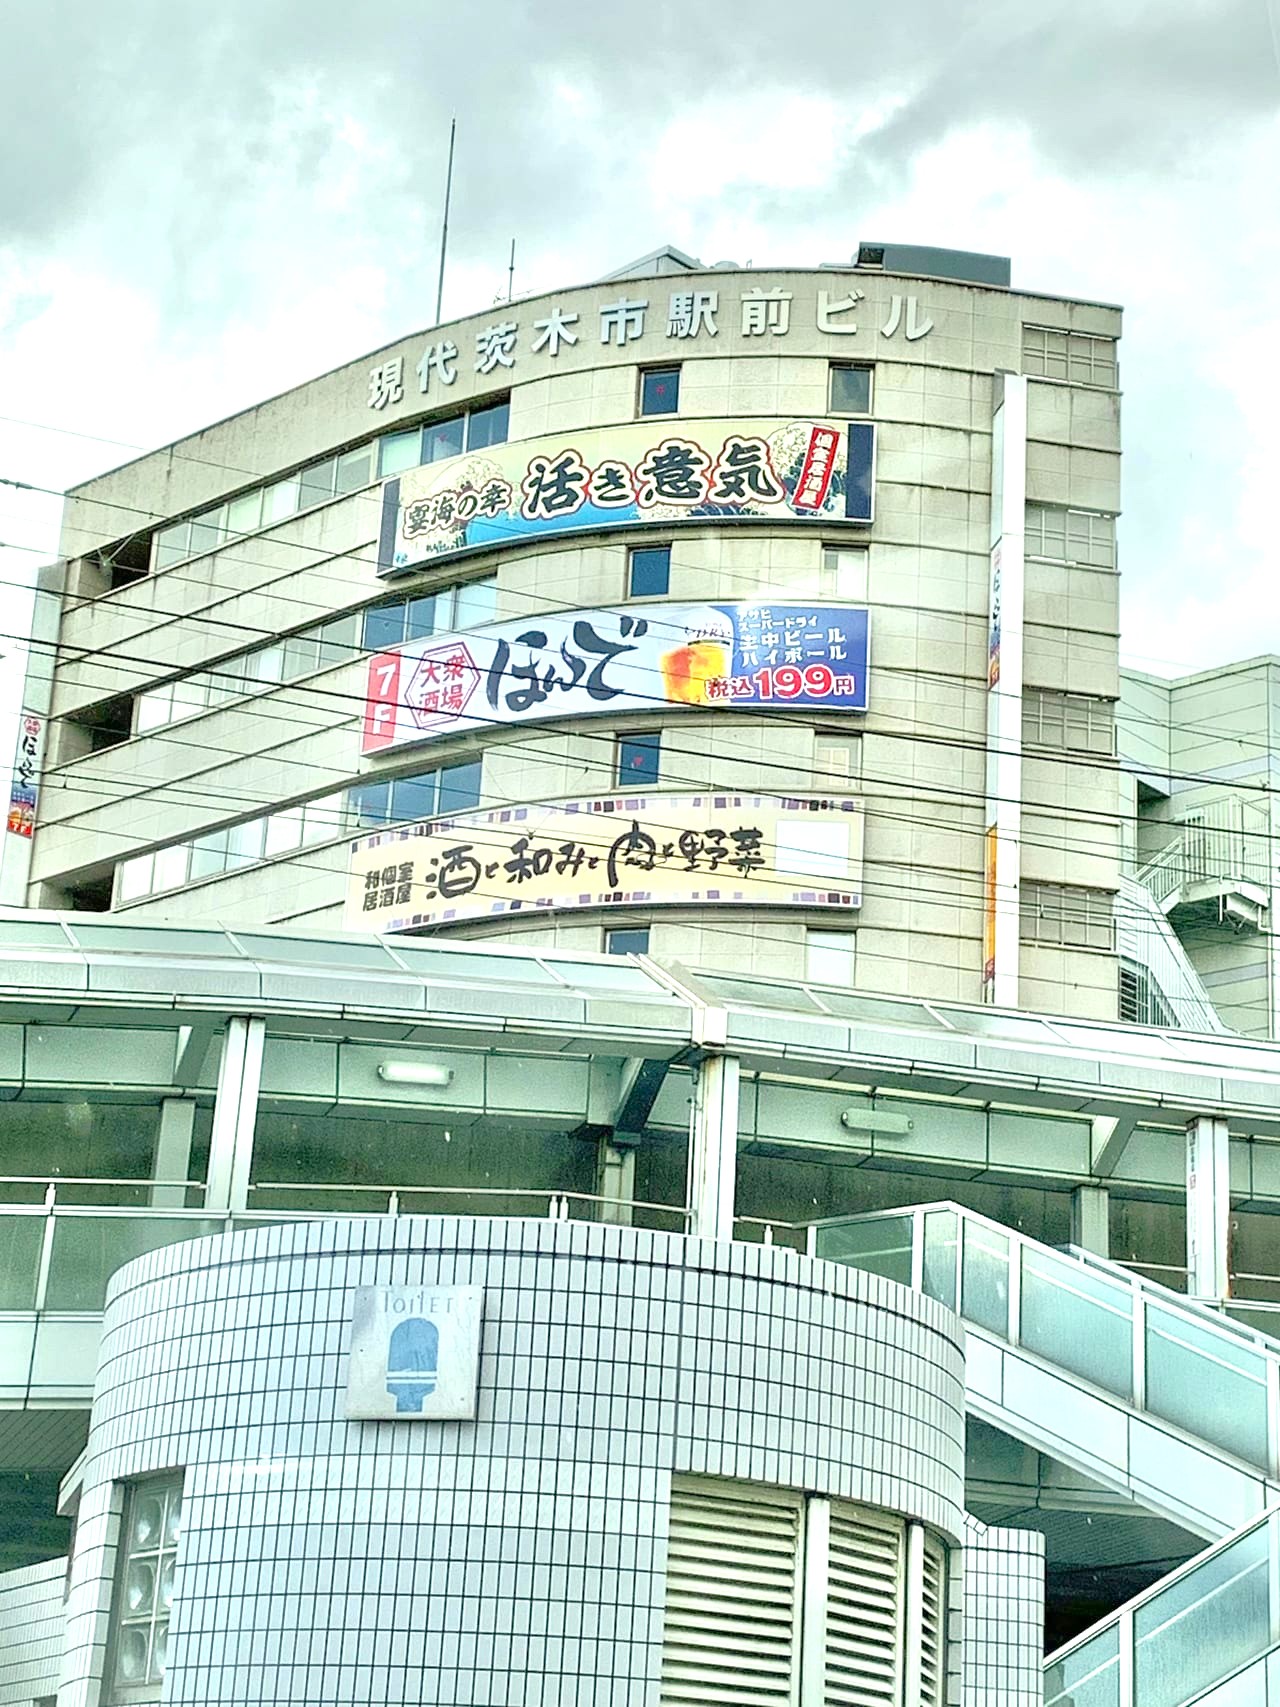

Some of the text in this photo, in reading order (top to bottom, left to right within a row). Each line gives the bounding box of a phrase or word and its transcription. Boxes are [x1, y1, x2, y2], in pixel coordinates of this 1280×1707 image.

[367, 286, 935, 410] 現代茨木市駅前ビル
[527, 442, 778, 514] 活き意気
[738, 615, 818, 632] スーパードライ
[740, 627, 847, 651] 生中ビール
[420, 654, 465, 688] 大衆
[486, 615, 648, 712] ほんで
[742, 645, 848, 667] ハイボール
[418, 684, 464, 717] 酒場
[365, 861, 414, 890] 和個室
[363, 882, 412, 911] 居酒屋
